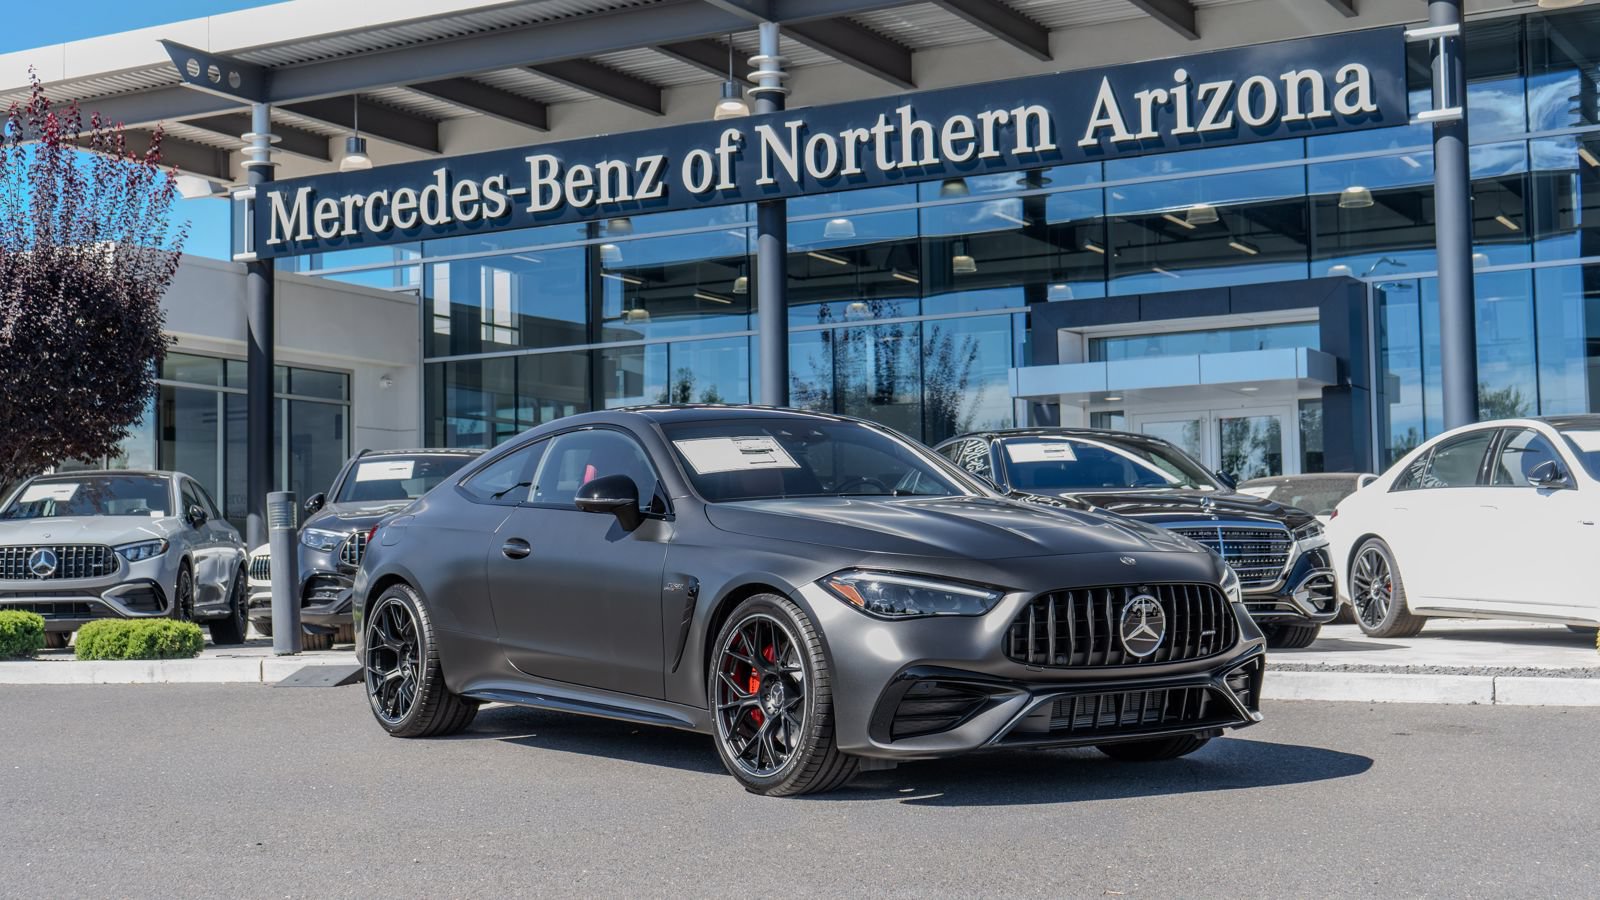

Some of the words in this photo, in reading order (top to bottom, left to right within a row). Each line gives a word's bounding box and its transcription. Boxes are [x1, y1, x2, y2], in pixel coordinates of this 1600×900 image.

[266, 154, 667, 245] Mercedes-Benz
[681, 128, 741, 194] of
[754, 104, 1057, 186] Northern
[1077, 62, 1377, 147] Arizona
